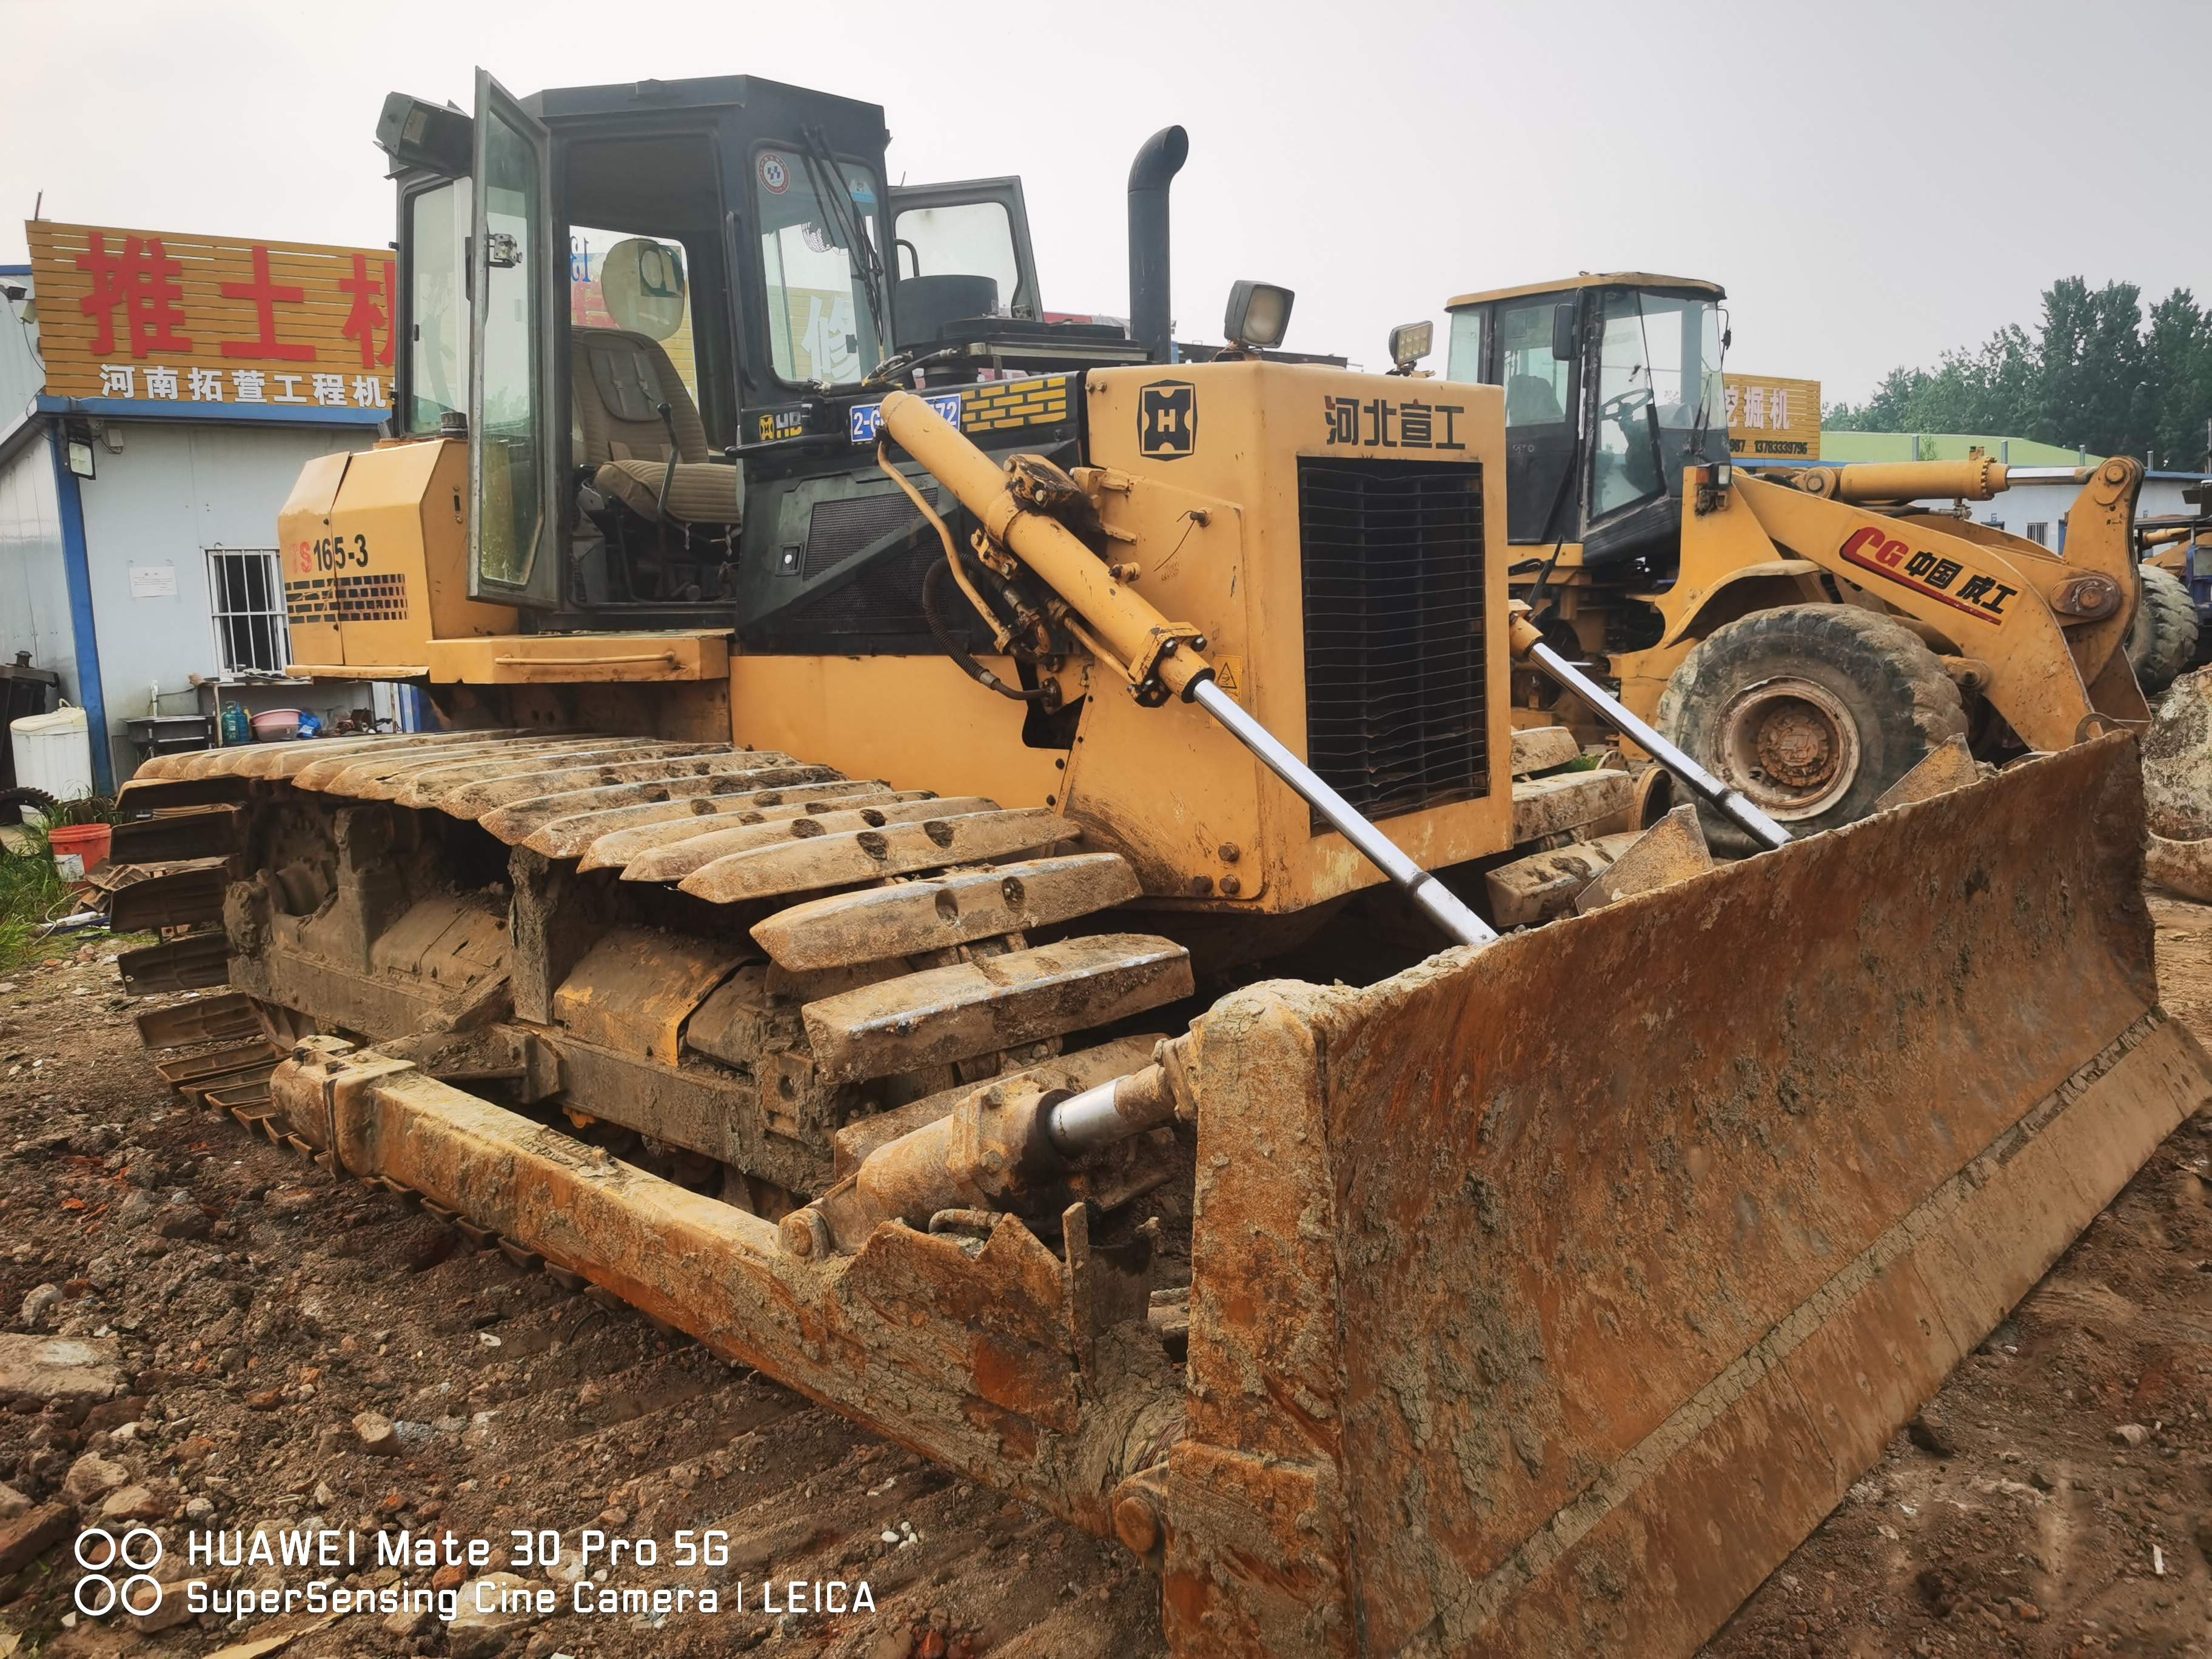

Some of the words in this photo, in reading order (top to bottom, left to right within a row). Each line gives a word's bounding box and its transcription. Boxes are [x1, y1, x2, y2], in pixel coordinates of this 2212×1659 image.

[99, 364, 396, 407] 河南拓萱工程机
[1324, 395, 1466, 450] 河北宣工
[1904, 551, 1963, 589] 中国
